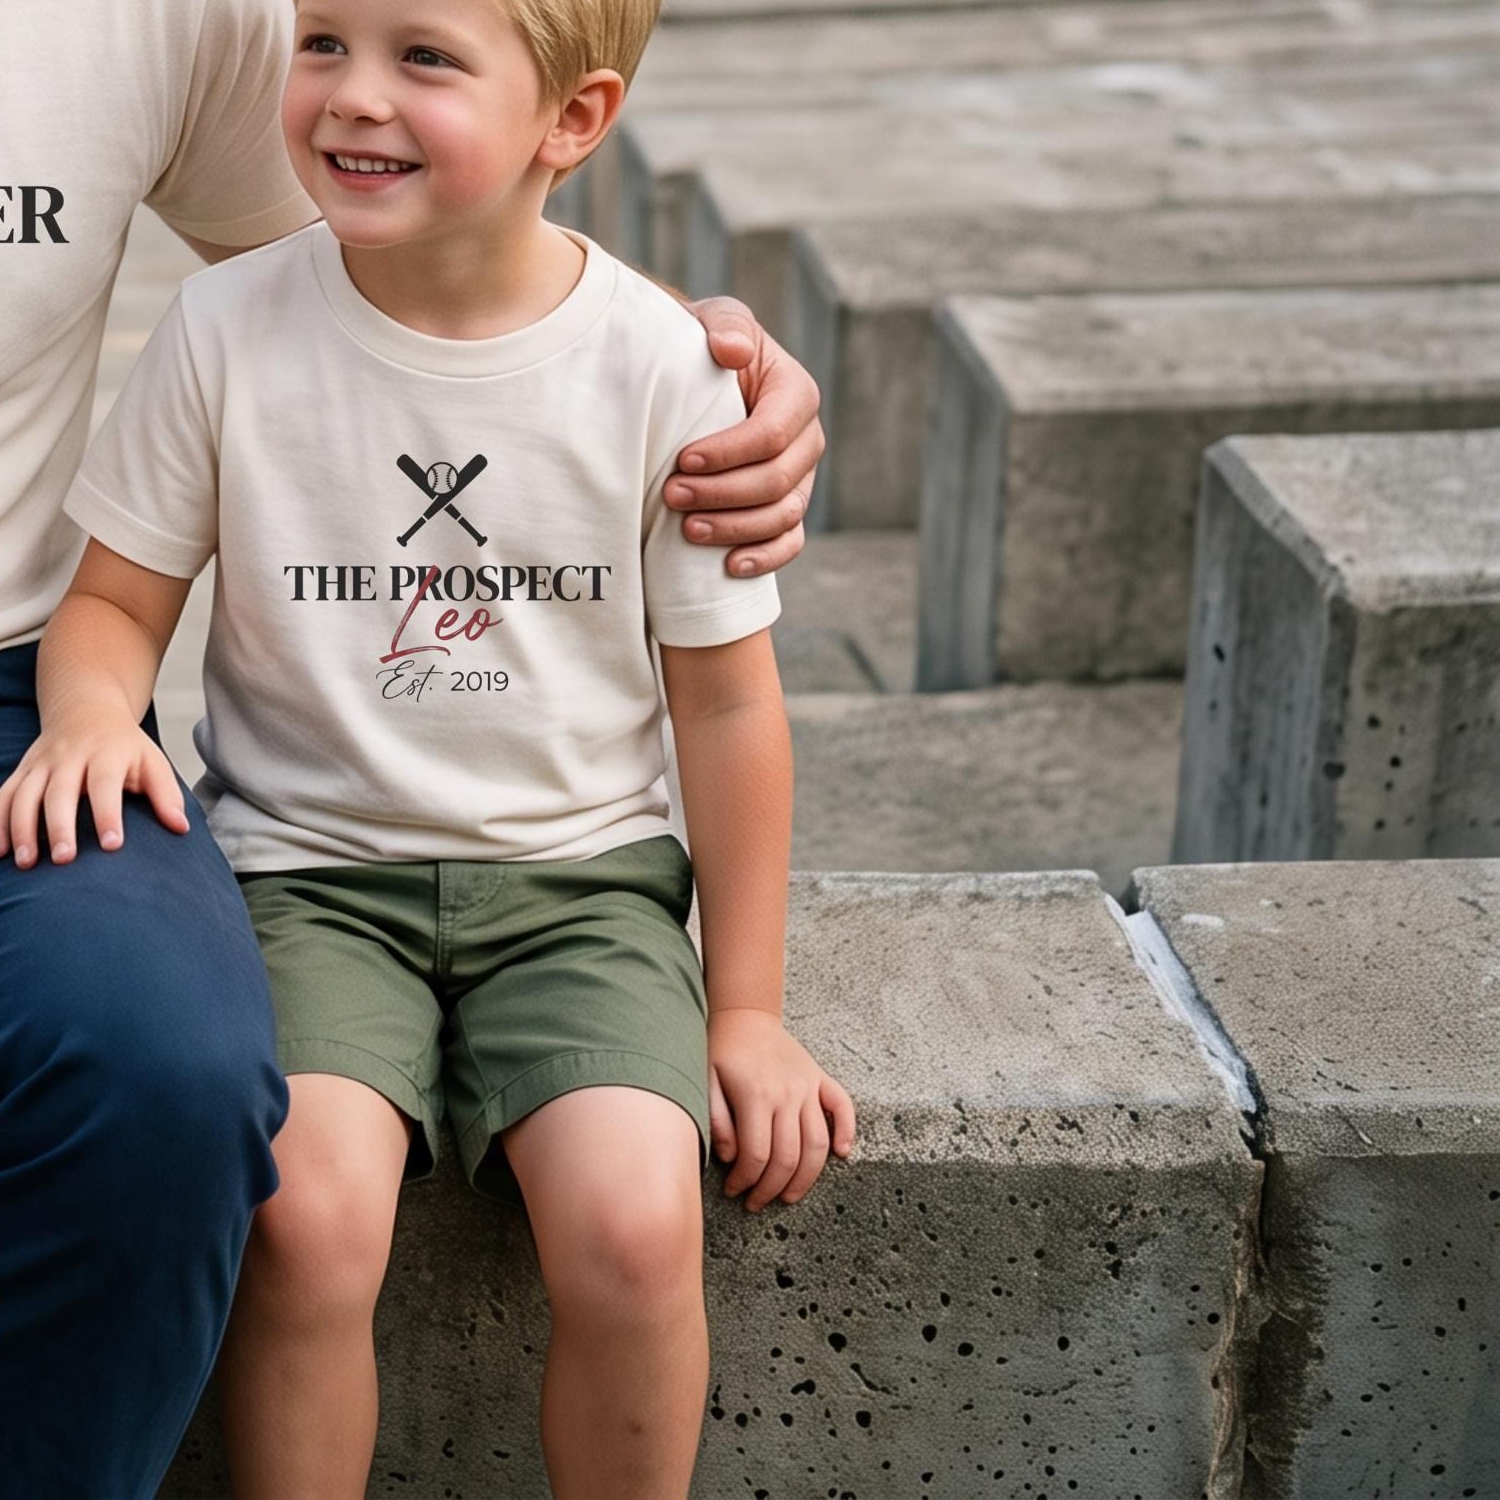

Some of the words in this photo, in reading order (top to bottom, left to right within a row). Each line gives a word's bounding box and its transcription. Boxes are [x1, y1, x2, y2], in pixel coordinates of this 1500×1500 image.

[284, 565, 377, 601] THE
[389, 565, 612, 602] PROSPECT
[380, 564, 504, 664] Leo
[376, 659, 443, 702] Est.
[451, 671, 509, 692] 2019
